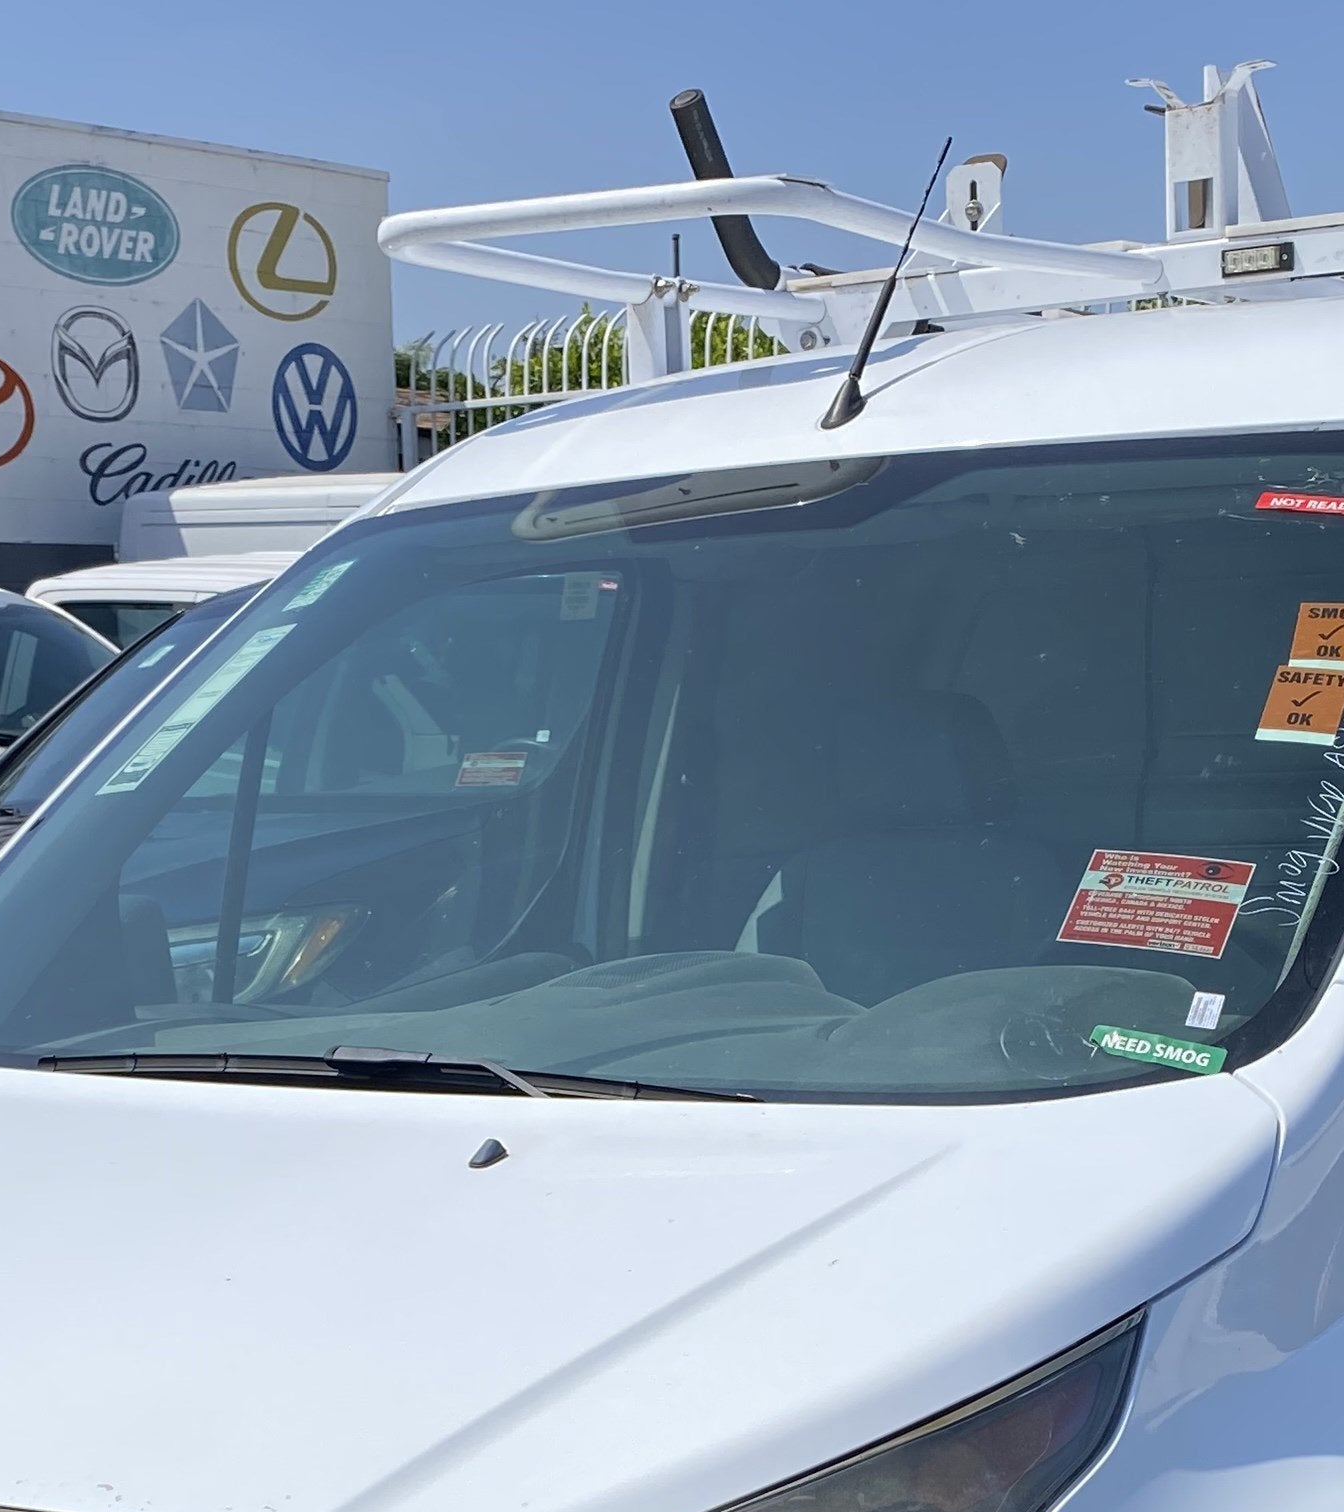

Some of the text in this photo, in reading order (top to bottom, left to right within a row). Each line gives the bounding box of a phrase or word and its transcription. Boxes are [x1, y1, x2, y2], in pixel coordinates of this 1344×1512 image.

[47, 184, 128, 223] LAND
[58, 223, 156, 263] ROVER
[1269, 497, 1306, 508] NOT
[1316, 645, 1343, 658] OK
[1286, 712, 1314, 726] OK
[1101, 1033, 1212, 1067] NEED SMOG
